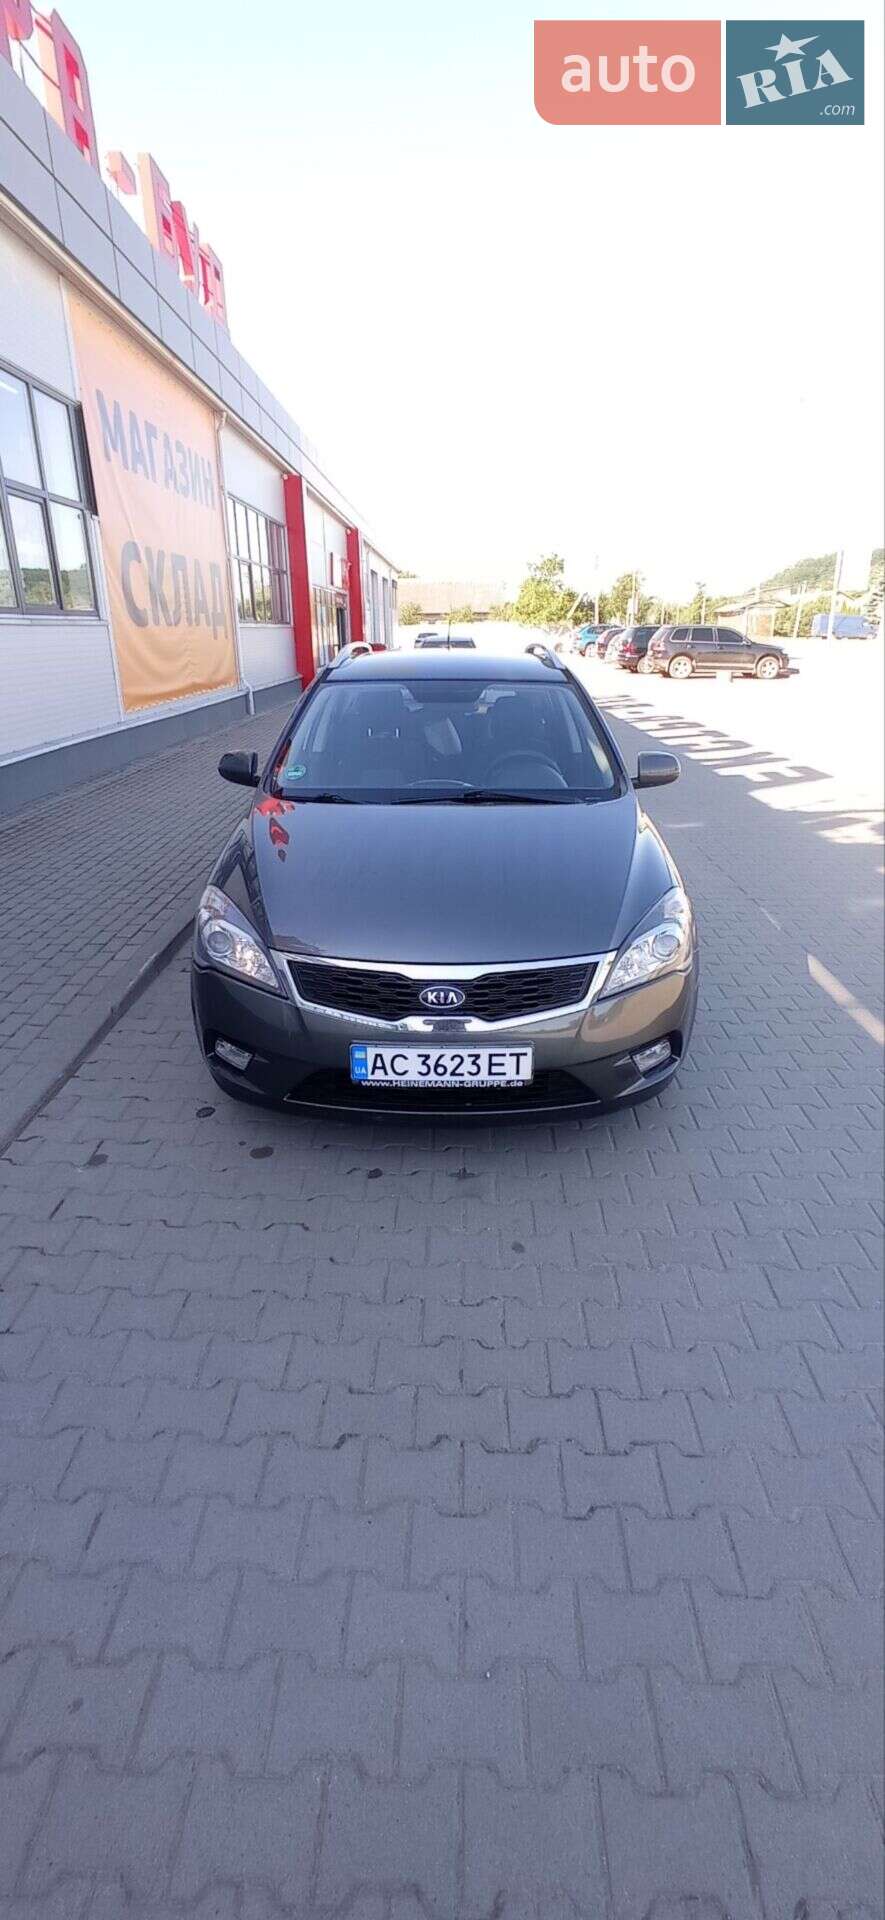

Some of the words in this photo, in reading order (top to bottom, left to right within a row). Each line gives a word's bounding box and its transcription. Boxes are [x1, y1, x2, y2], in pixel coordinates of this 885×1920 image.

[96, 389, 217, 511] МАГАЗИН
[121, 541, 229, 640] СКЛАД
[427, 991, 458, 1004] KIA
[370, 1053, 409, 1076] AC
[417, 1053, 481, 1077] 3623
[487, 1052, 528, 1076] ET
